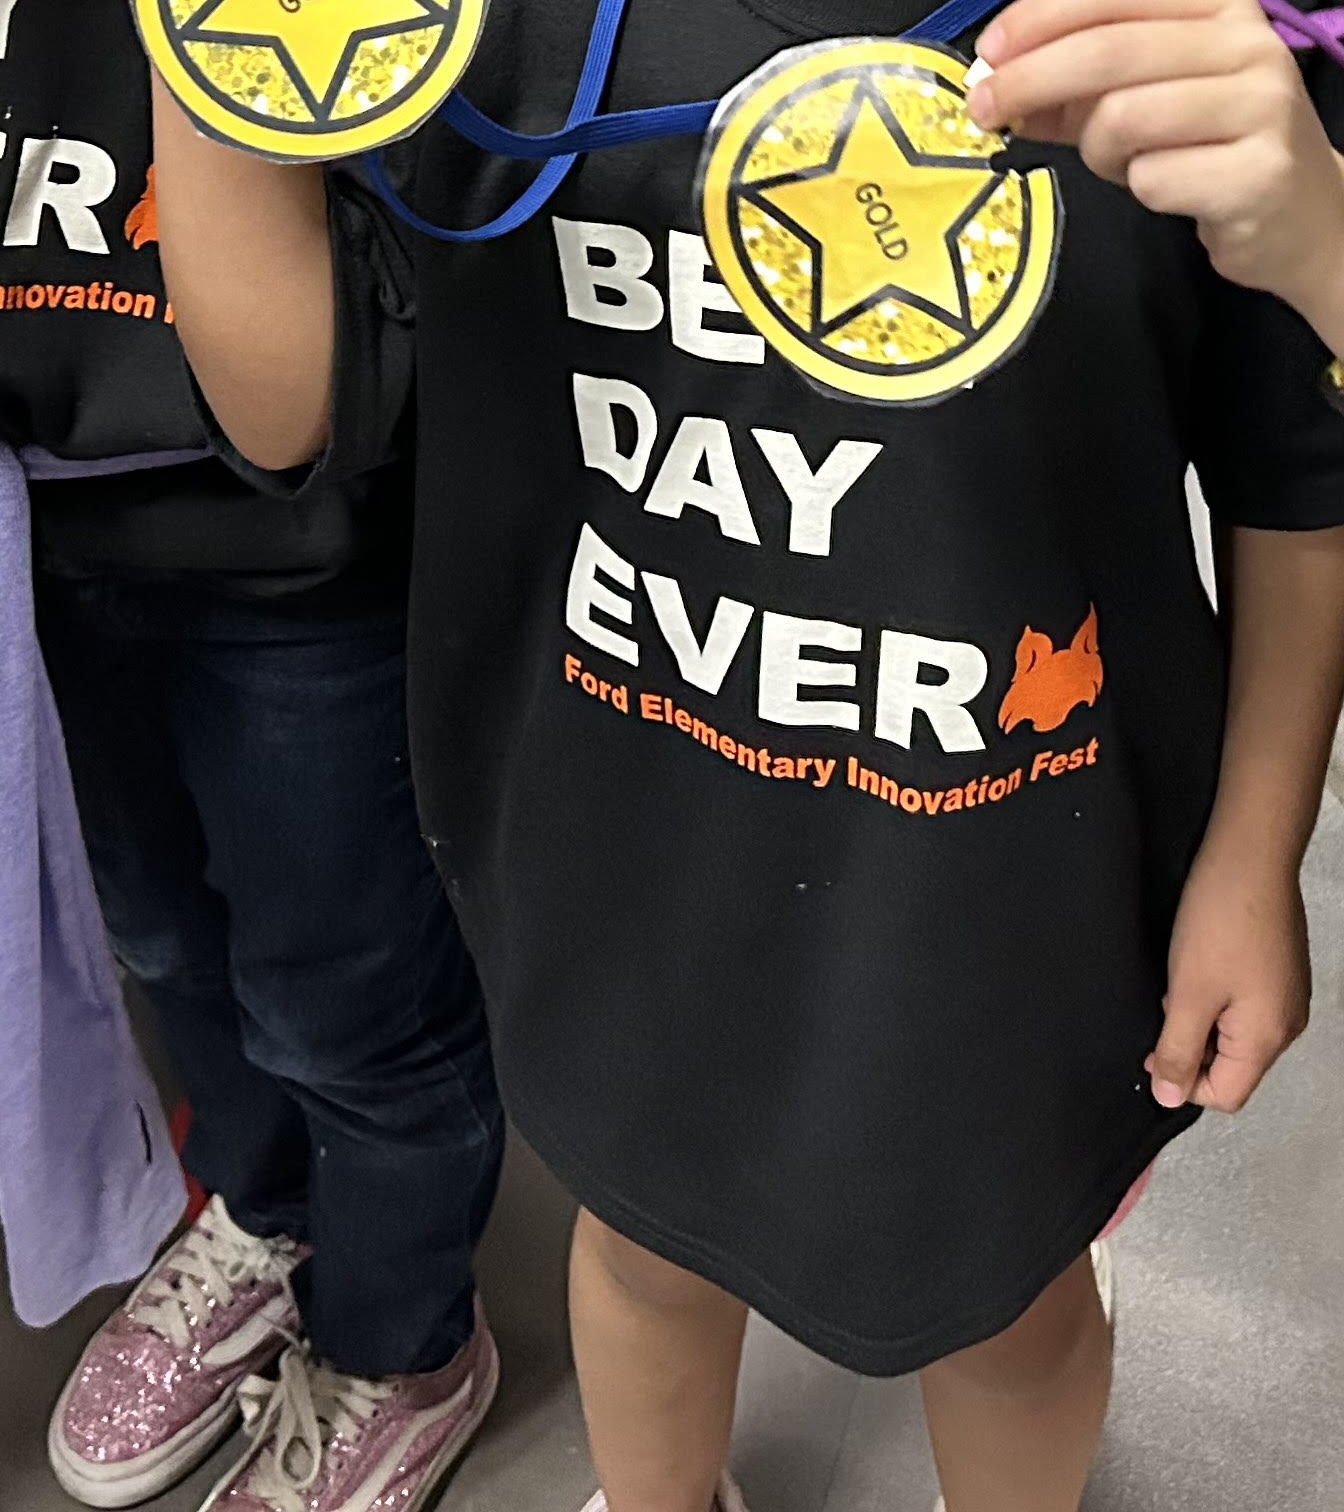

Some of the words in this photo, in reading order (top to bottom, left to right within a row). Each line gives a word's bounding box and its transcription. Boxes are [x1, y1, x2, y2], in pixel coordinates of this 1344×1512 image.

[551, 215, 766, 365] BE
[855, 182, 909, 260] GOLD
[572, 371, 885, 558] DAY
[564, 521, 989, 755] EVER
[563, 652, 629, 715] Ford
[639, 692, 837, 789] Elementary
[846, 756, 1023, 816] Innovation
[1028, 736, 1100, 783] Fest
